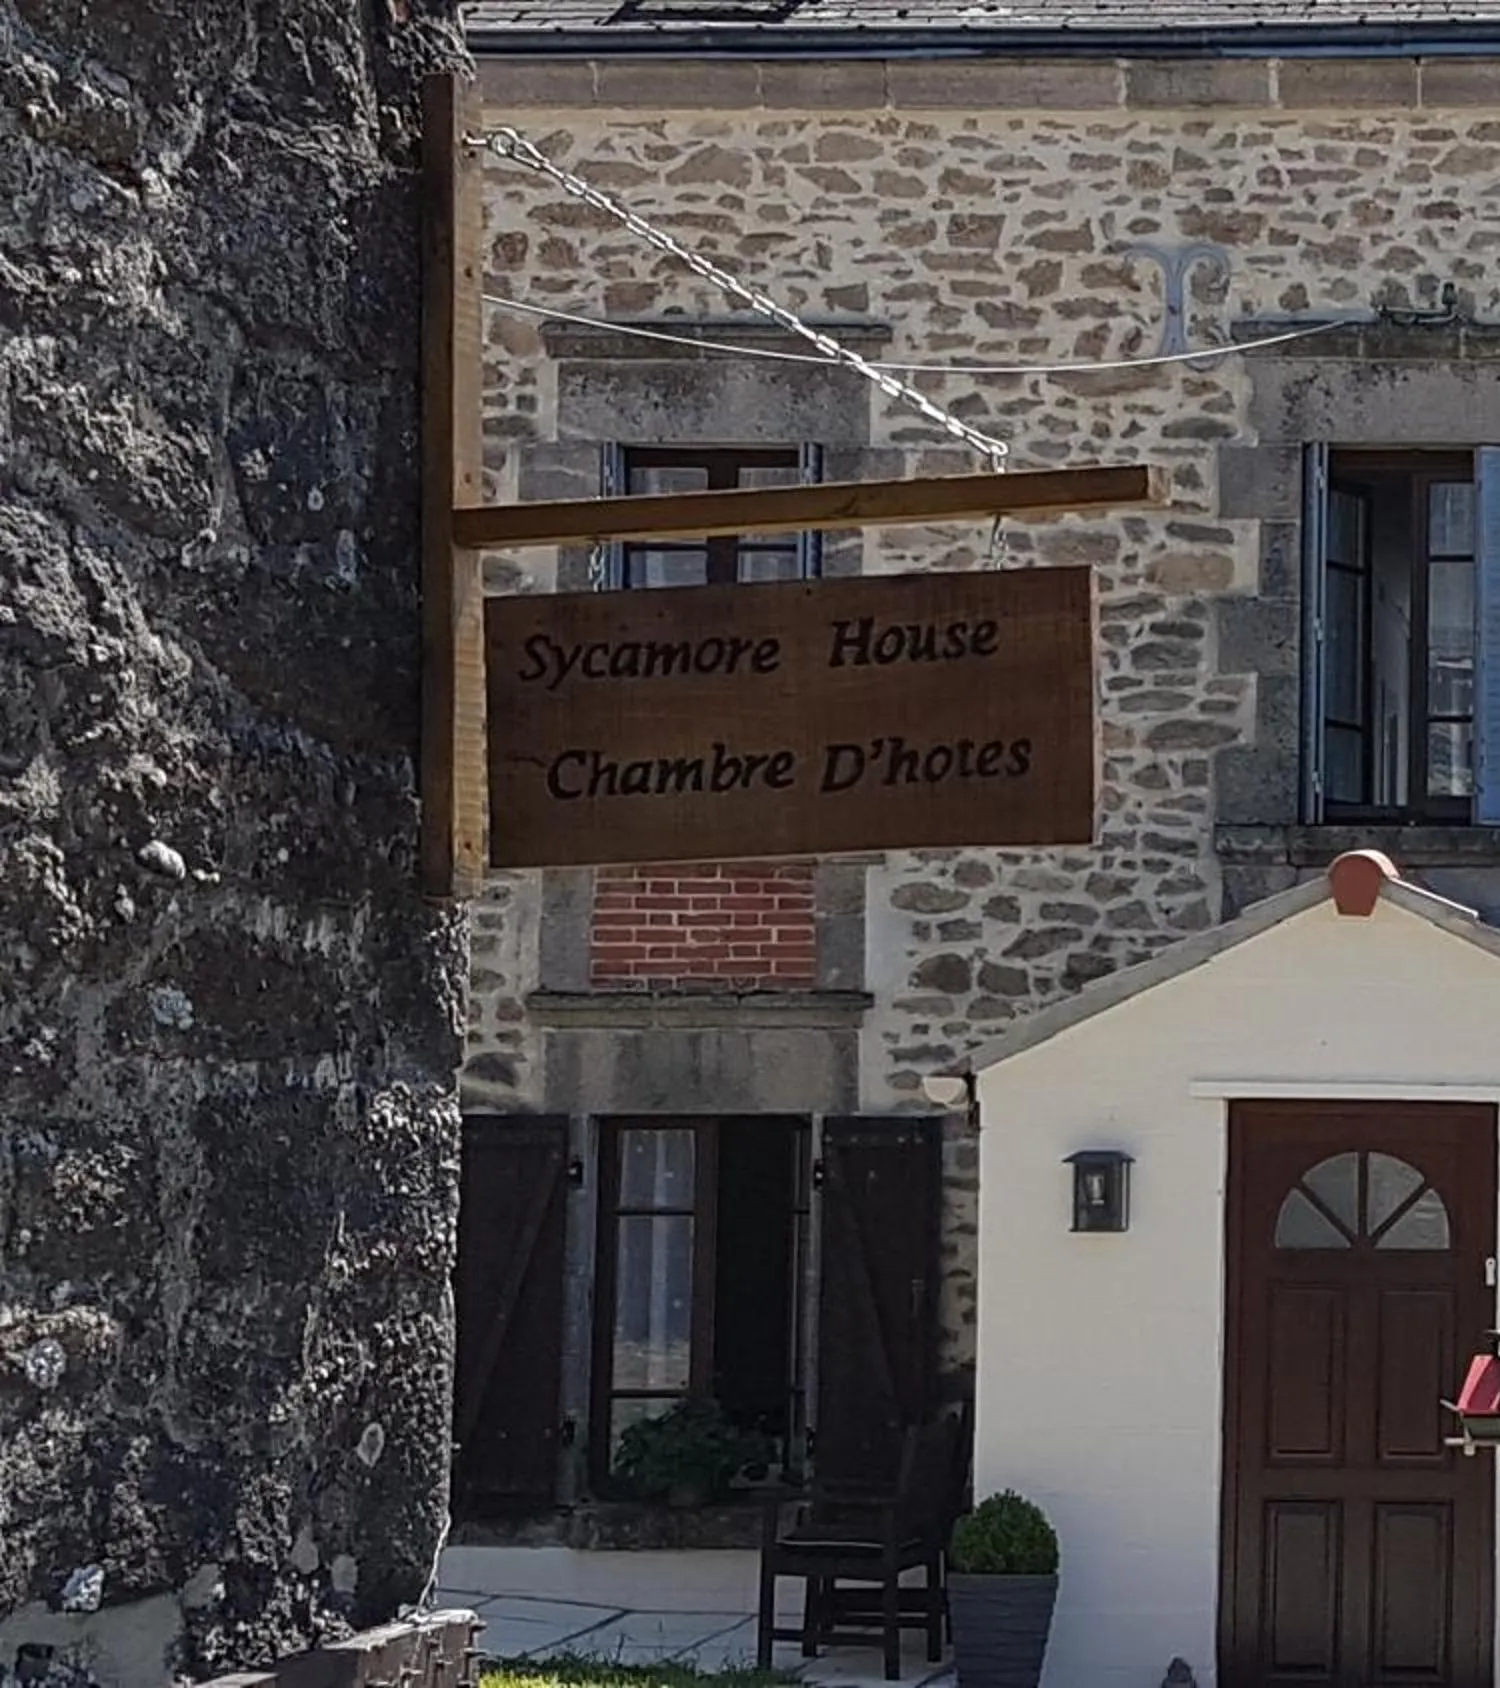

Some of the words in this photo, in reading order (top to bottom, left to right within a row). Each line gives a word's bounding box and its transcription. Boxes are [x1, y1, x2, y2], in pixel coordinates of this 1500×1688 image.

[519, 634, 780, 689] Sycamore
[828, 618, 998, 668] House
[546, 744, 794, 798] Chambre
[820, 737, 1032, 793] D'hotes
